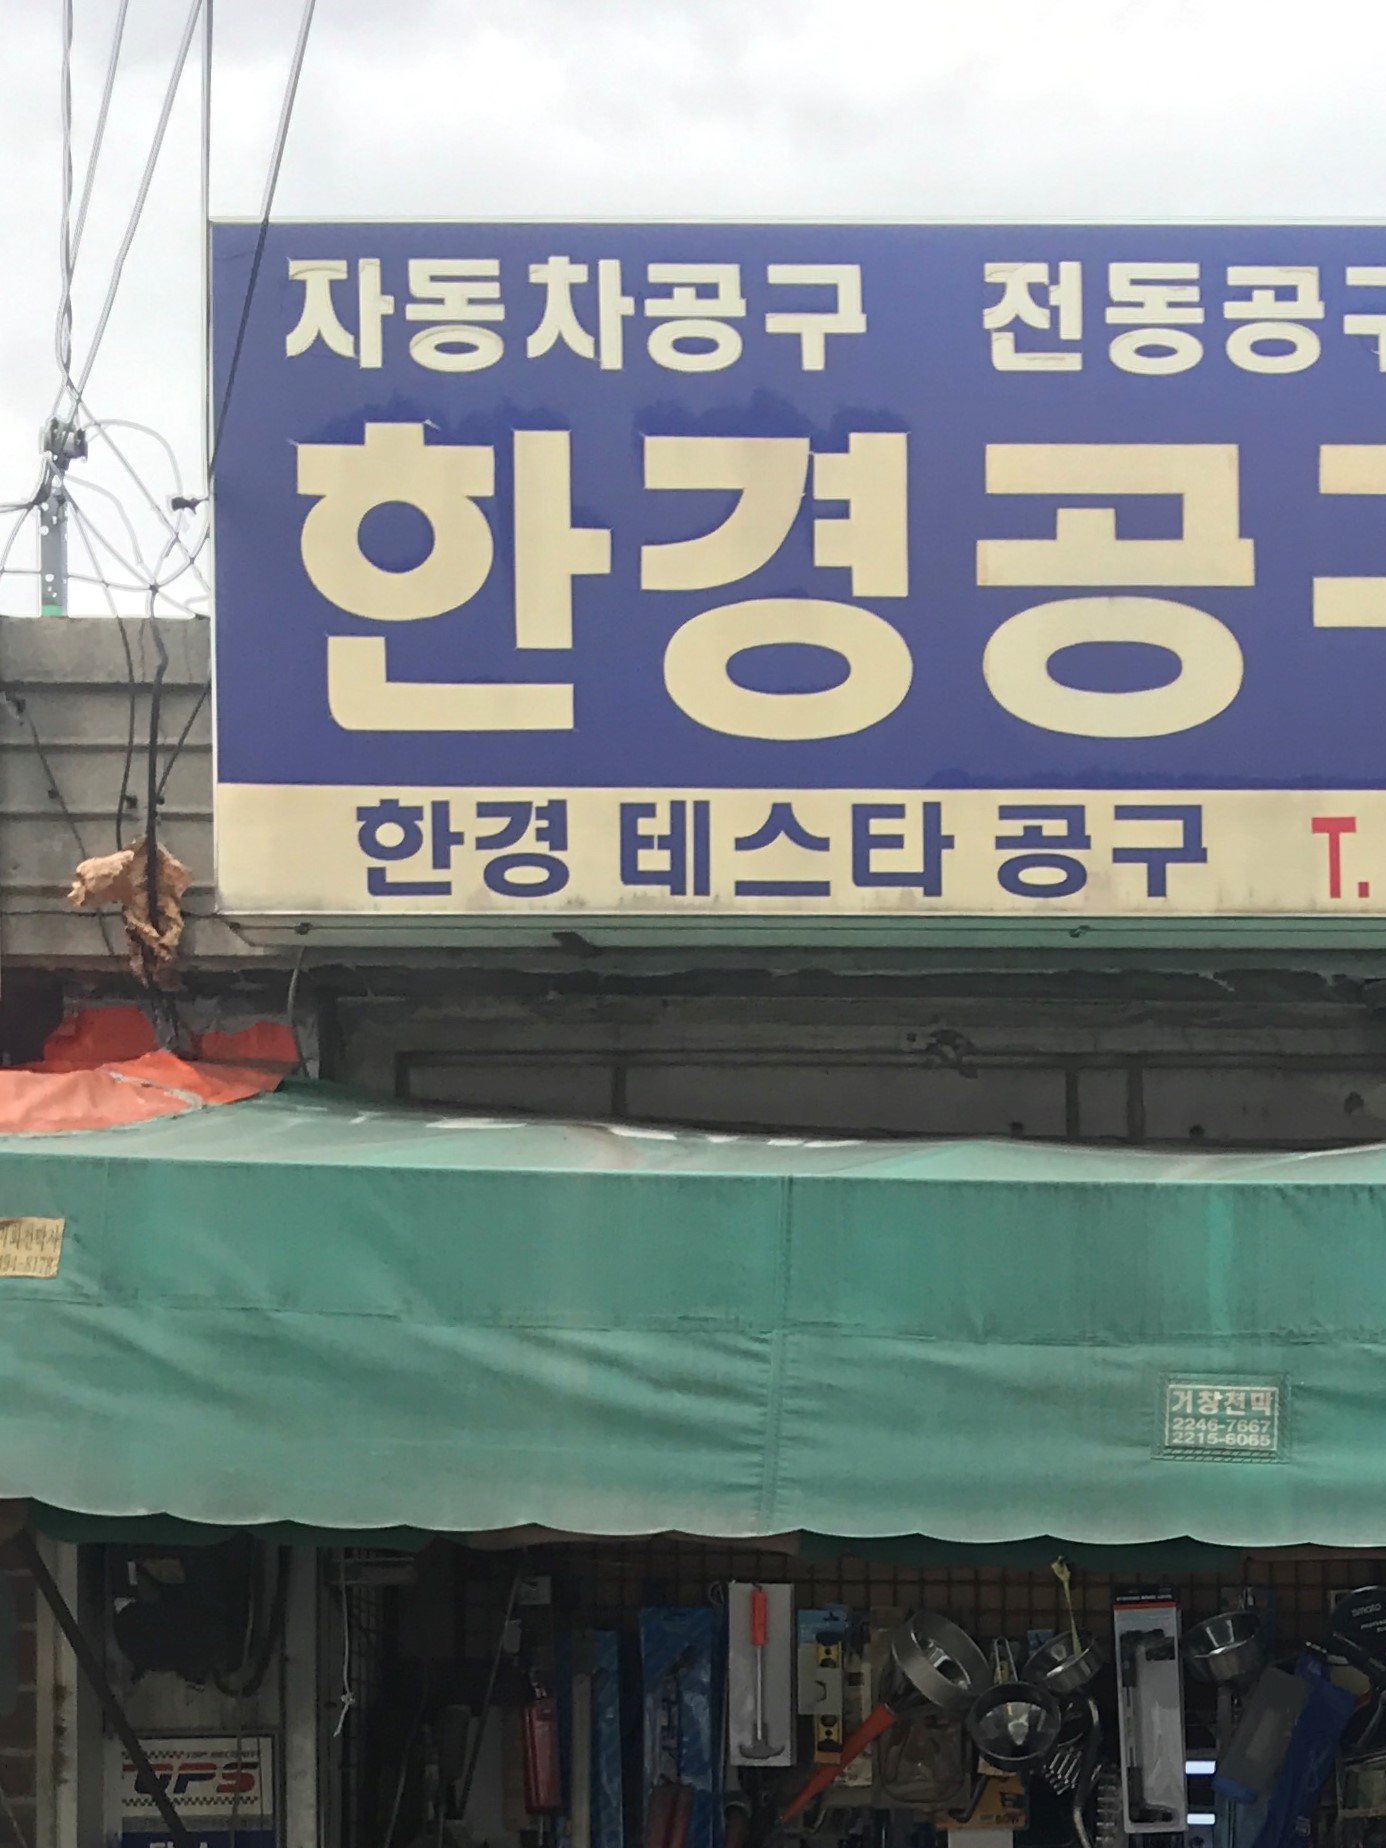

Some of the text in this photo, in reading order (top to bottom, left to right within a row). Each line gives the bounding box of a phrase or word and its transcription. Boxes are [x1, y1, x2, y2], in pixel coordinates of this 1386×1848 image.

[285, 255, 868, 373] 자동차공구
[354, 798, 569, 899] 한경
[617, 800, 955, 898] 테스타
[994, 803, 1209, 899] 공구
[1310, 815, 1372, 900] T.
